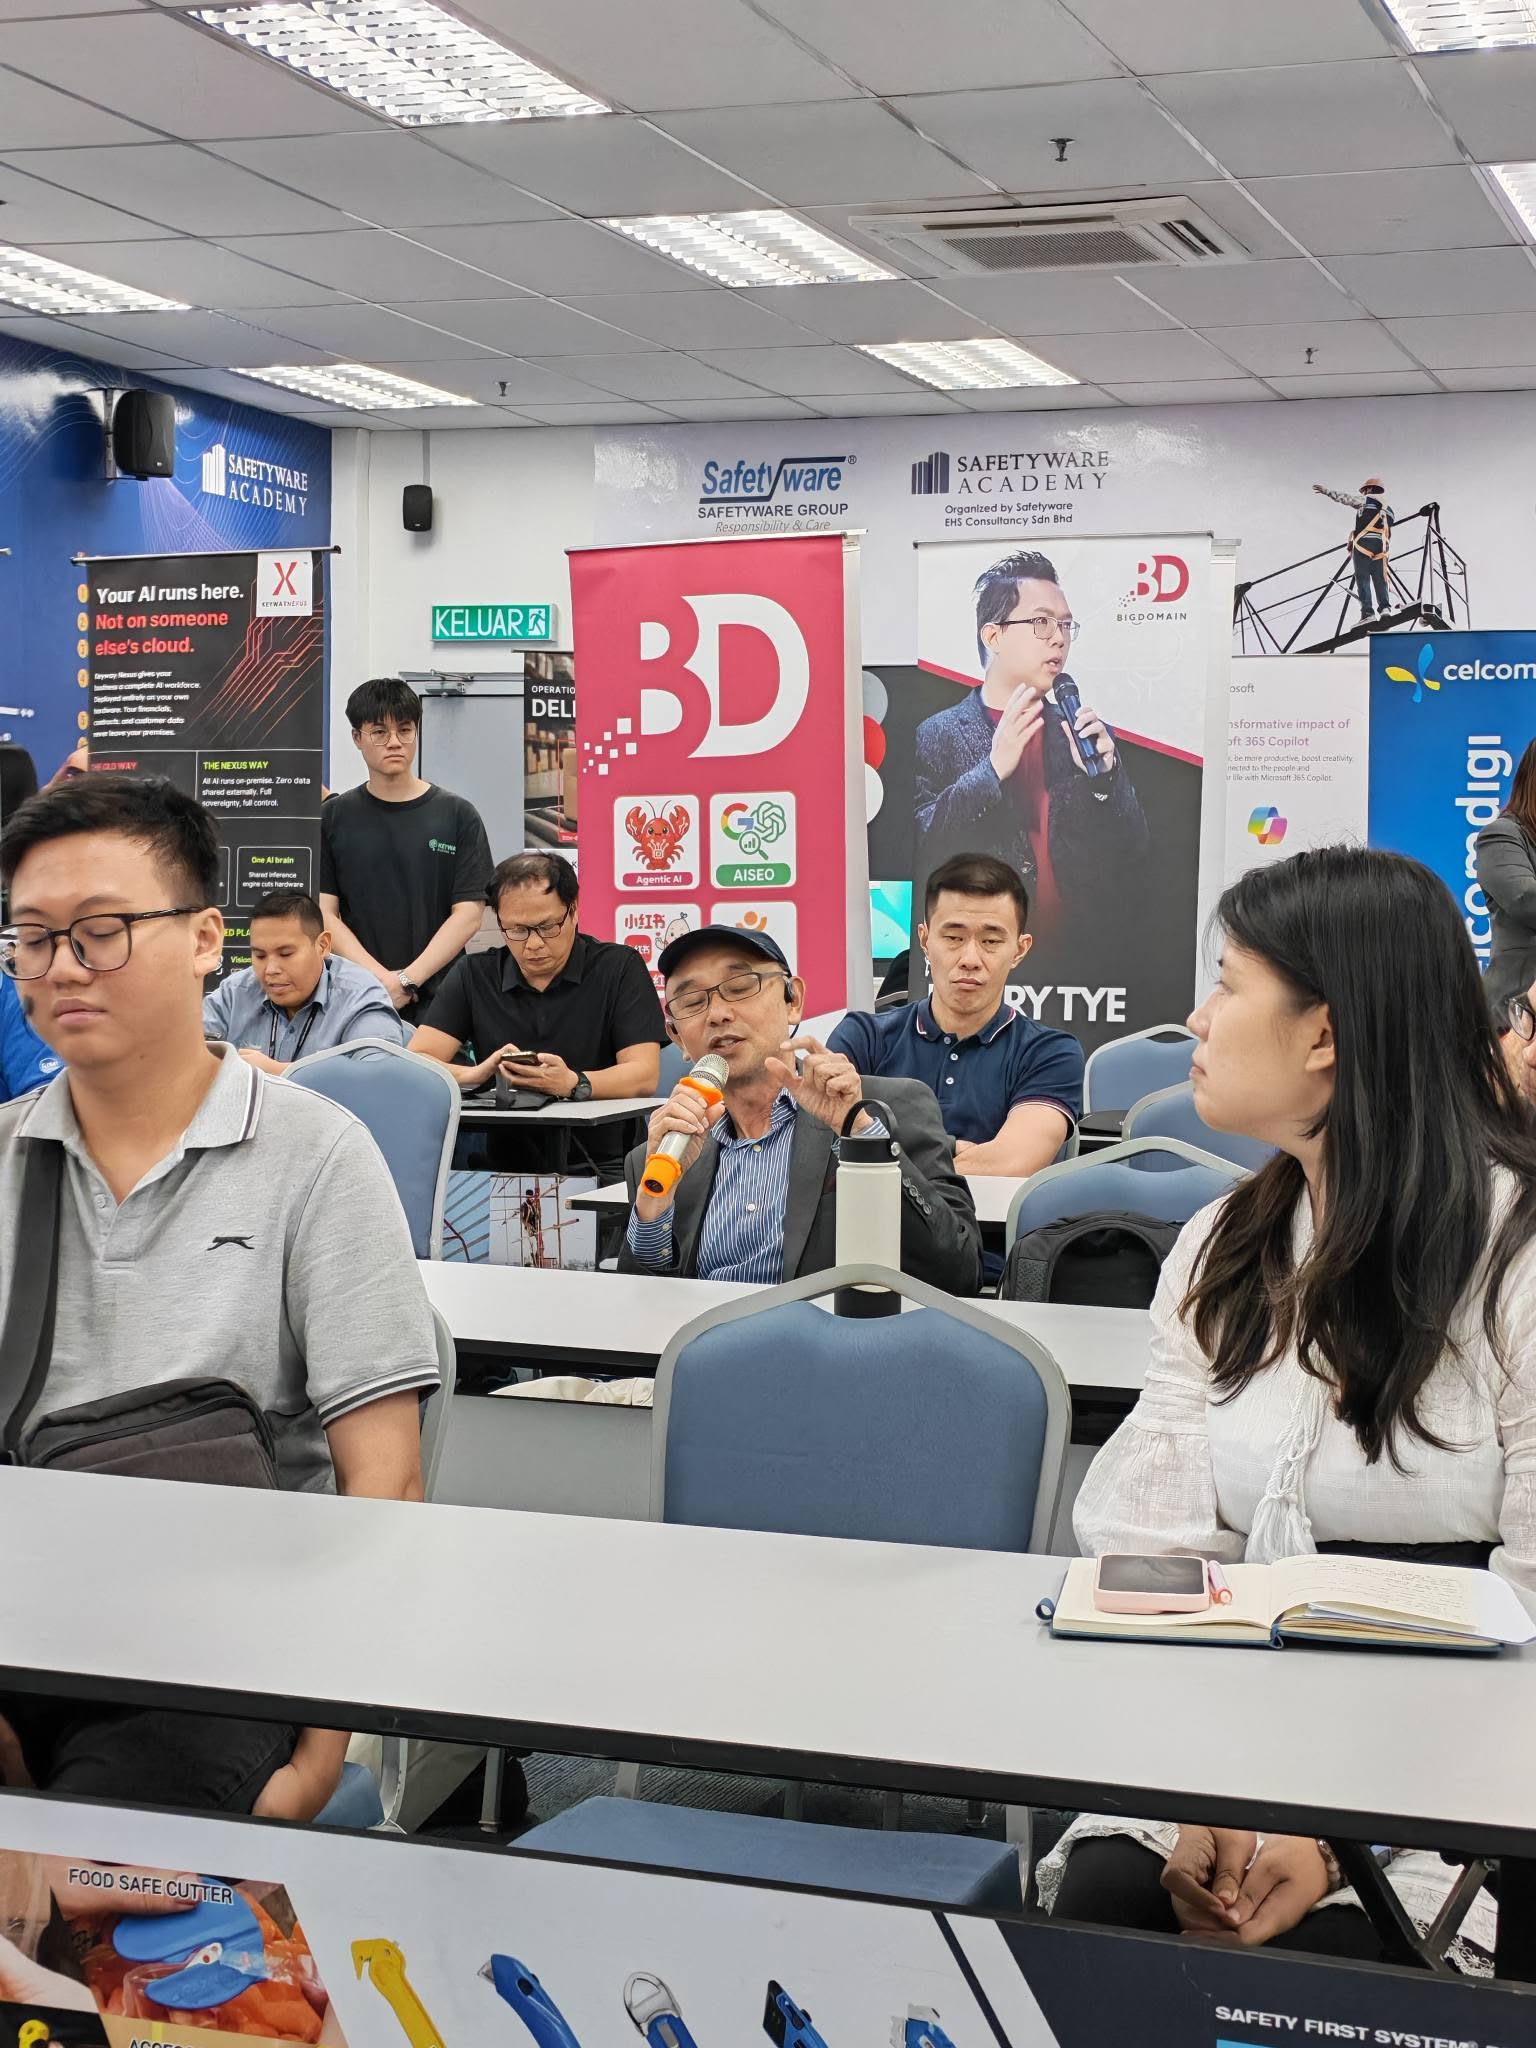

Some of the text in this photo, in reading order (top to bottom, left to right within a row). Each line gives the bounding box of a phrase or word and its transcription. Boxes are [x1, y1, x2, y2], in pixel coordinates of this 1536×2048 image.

[957, 451, 1109, 473] SAFETYWARE
[228, 454, 308, 492] SAFETYWARE
[958, 473, 1107, 494] ACADEMY
[229, 481, 308, 516] ACADEMY
[698, 503, 849, 519] SAFETYWARE GROUP
[945, 502, 1073, 515] Organized by Safetyware
[715, 519, 832, 535] Responsibility & Care
[944, 514, 1073, 527] EHS Consultancy Sdn Bhd
[97, 584, 245, 604] Your AI runs here.
[96, 612, 229, 630] Not on someone
[435, 607, 524, 637] KELUAR
[1116, 613, 1187, 621] BIGDOMAIN
[95, 637, 195, 656] else's cloud.
[1443, 659, 1536, 681] celcom
[531, 685, 576, 694] OPERATIO
[1296, 719, 1335, 731] impact
[1338, 718, 1351, 729] of
[1245, 736, 1265, 746] 365
[1268, 736, 1310, 748] Copilot
[203, 761, 268, 770] THE NEXUS WAY
[1260, 773, 1291, 781] Microsoft
[202, 788, 225, 796] shared
[260, 787, 272, 795] Full
[275, 856, 294, 864] brain
[636, 875, 682, 885] Agentic AI
[733, 868, 775, 882] AISEO
[274, 880, 304, 888] hardware
[624, 914, 666, 929] 小红书
[1057, 986, 1127, 1023] TYE
[68, 1868, 234, 1906] FOOD SAFE CUTTER
[1215, 2006, 1298, 2031] SAFETY
[1304, 2019, 1369, 2041] FIRST
